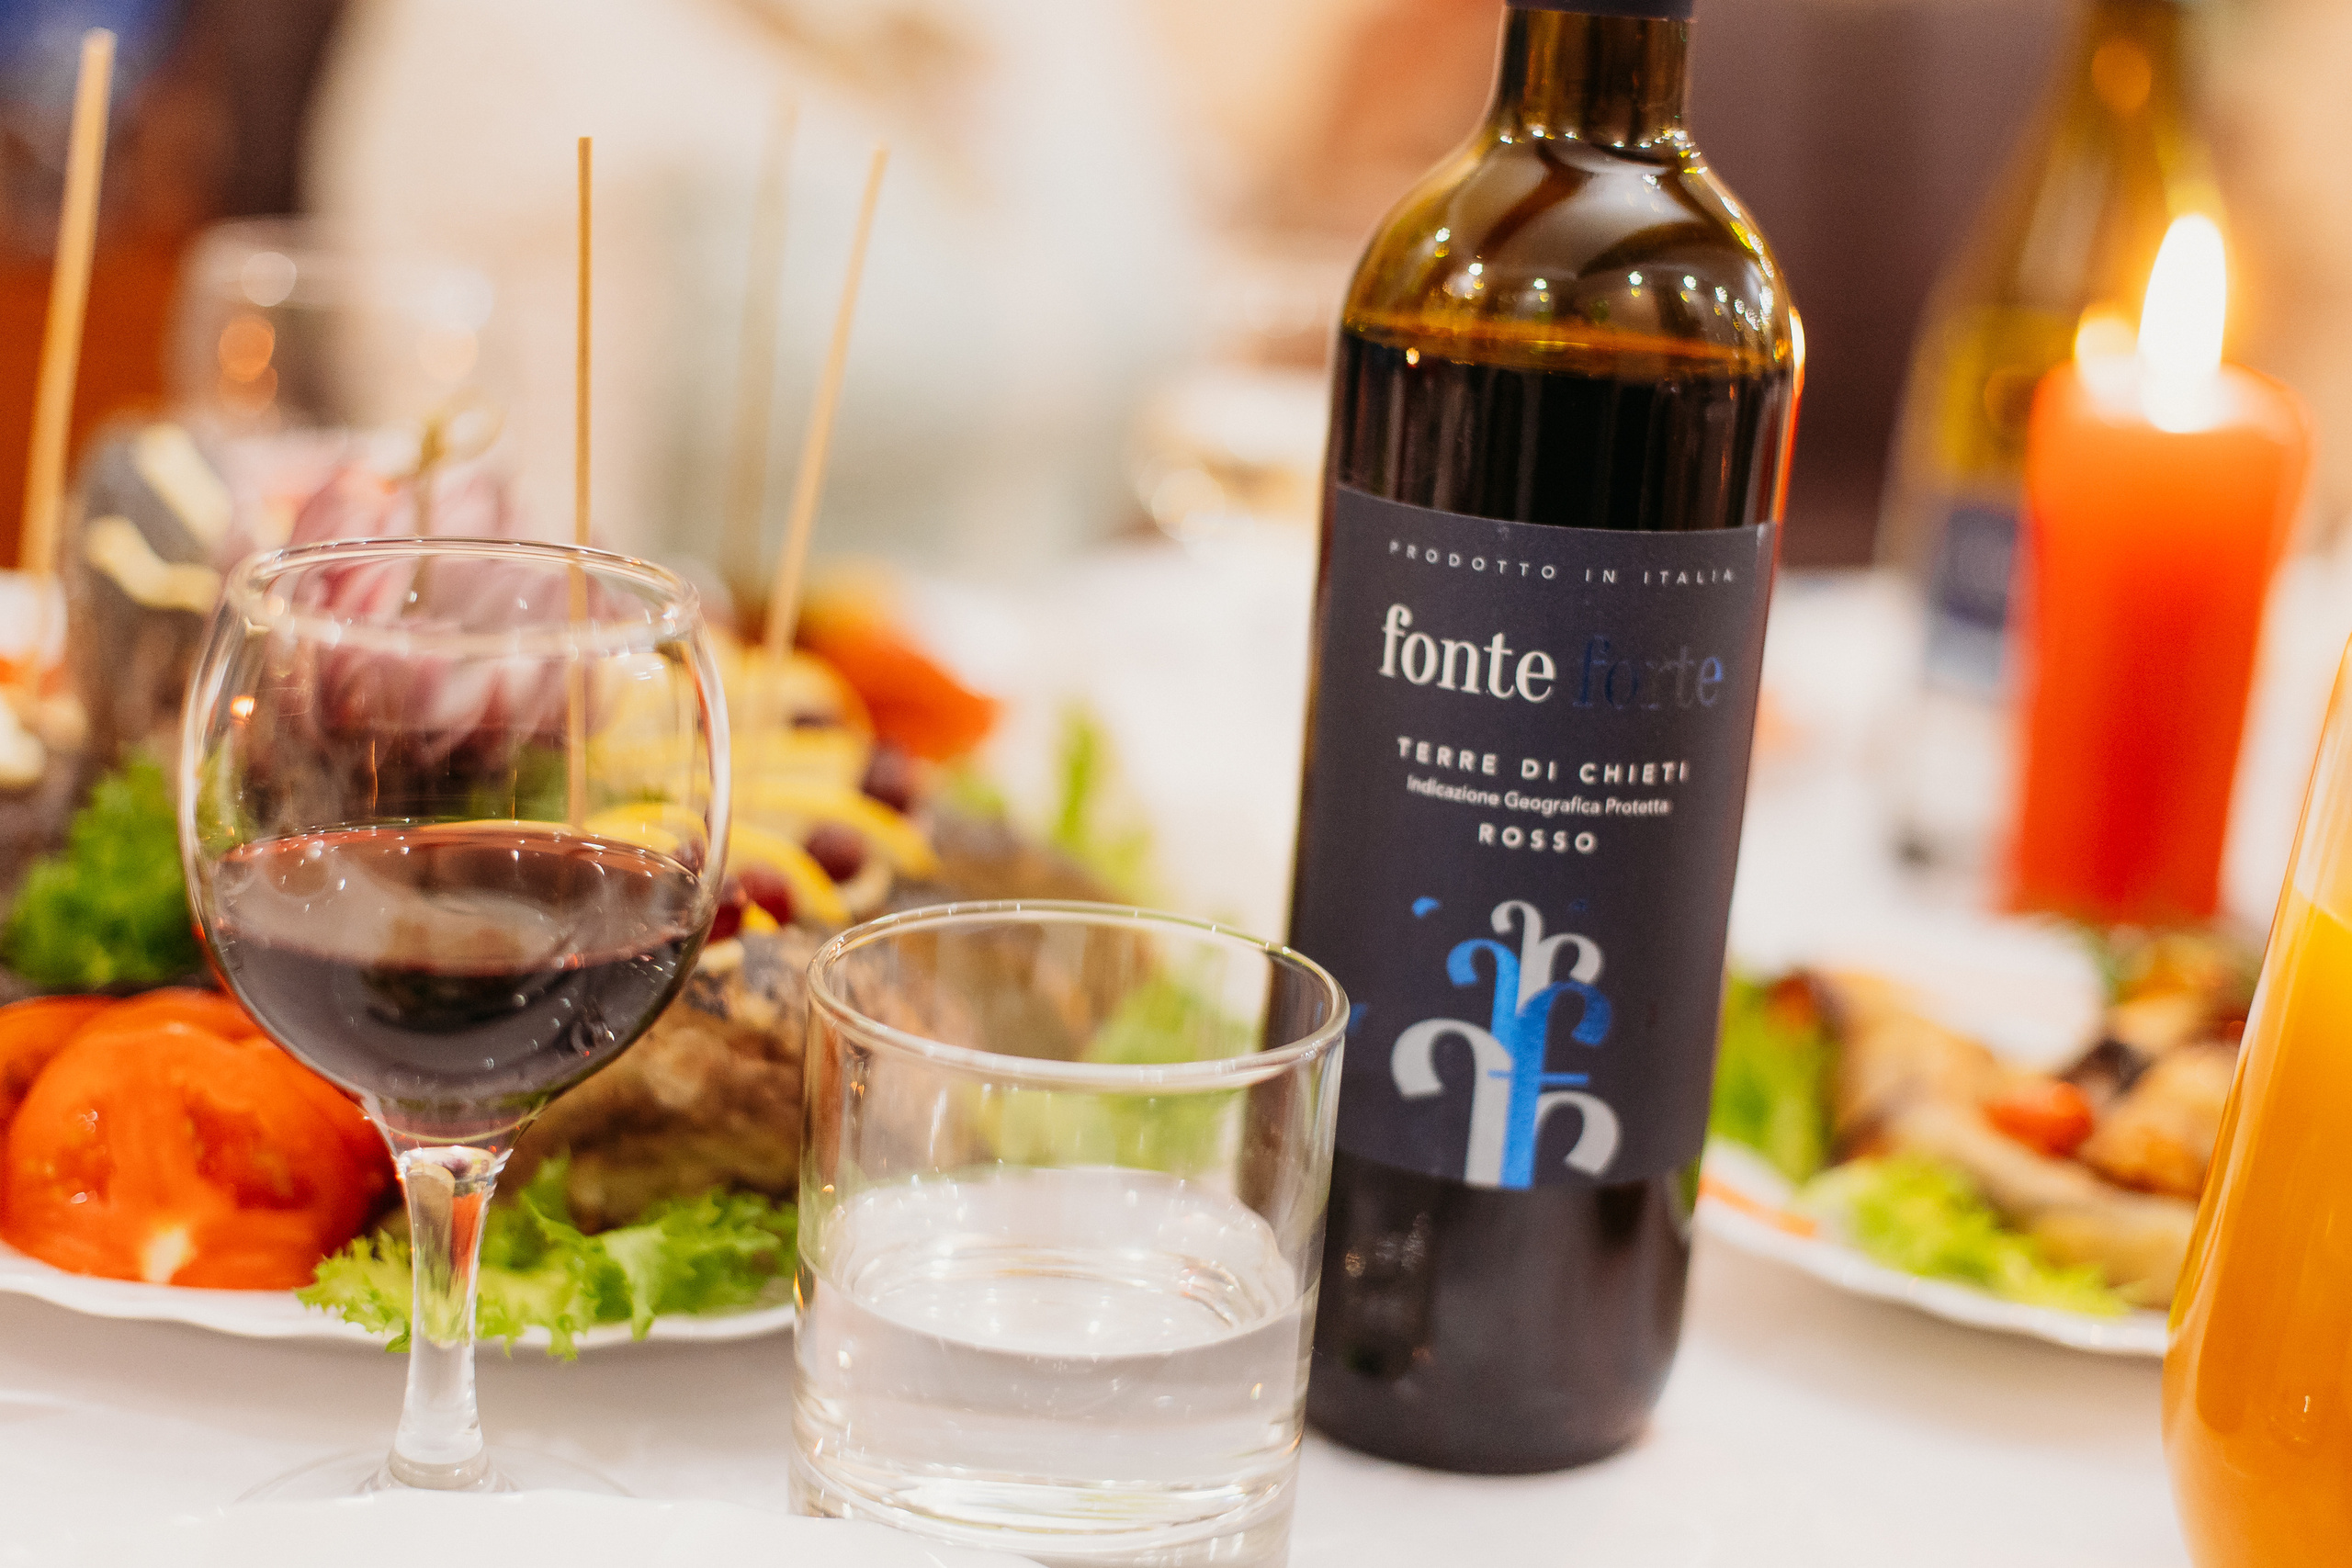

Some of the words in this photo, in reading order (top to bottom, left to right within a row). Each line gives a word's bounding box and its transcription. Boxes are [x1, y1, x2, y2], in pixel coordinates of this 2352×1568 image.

[1389, 540, 1556, 581] PRODOTTO
[1585, 569, 1617, 584] IN
[1644, 568, 1736, 585] ITALIA
[1379, 604, 1555, 703] fonte
[1572, 634, 1724, 711] forte
[1396, 736, 1499, 776] TERRE
[1520, 758, 1556, 783] DI
[1578, 761, 1690, 785] CHIETI
[1407, 774, 1500, 807] Indicazione
[1503, 790, 1600, 818] Geografica
[1605, 796, 1672, 816] Protetta
[1477, 822, 1598, 854] ROSSO
